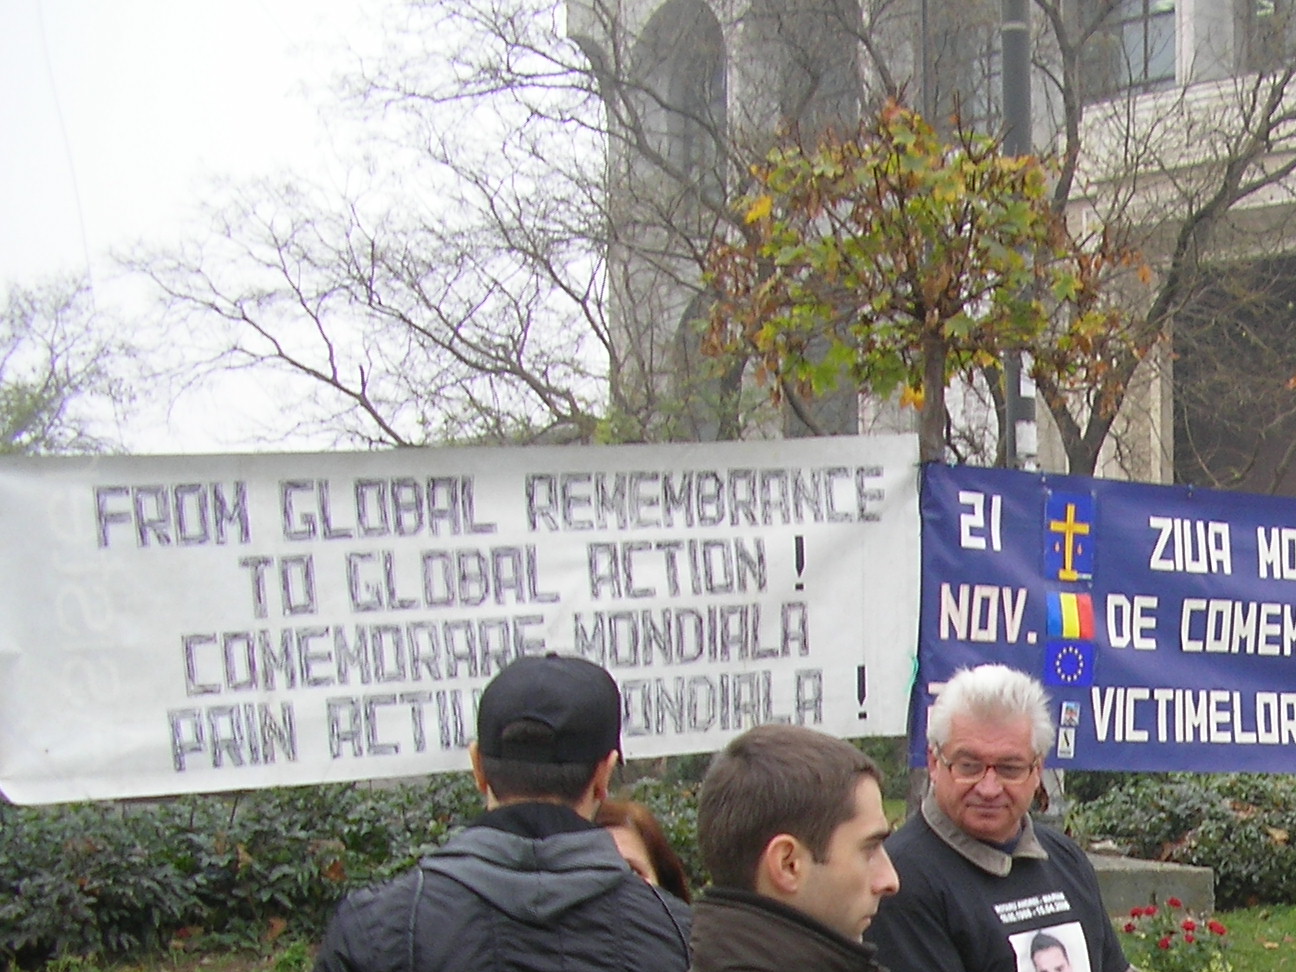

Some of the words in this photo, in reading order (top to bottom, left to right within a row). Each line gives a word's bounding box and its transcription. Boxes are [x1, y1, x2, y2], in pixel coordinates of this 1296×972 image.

[93, 481, 251, 549] FROM
[278, 473, 498, 542] GLOBAL
[525, 466, 885, 533] REMEMBRANCE
[958, 490, 1002, 551] 21
[239, 552, 318, 619] TO
[346, 543, 560, 612] GLOBAL
[588, 536, 768, 601] ACTION
[1150, 515, 1232, 575] ZIUA
[182, 614, 546, 696] COMEMORARE
[574, 601, 810, 668] MONDIALA
[940, 582, 1038, 645] NOV.
[1106, 593, 1158, 651] DE
[168, 701, 298, 772] PRIN
[621, 668, 824, 738] ONDIALA
